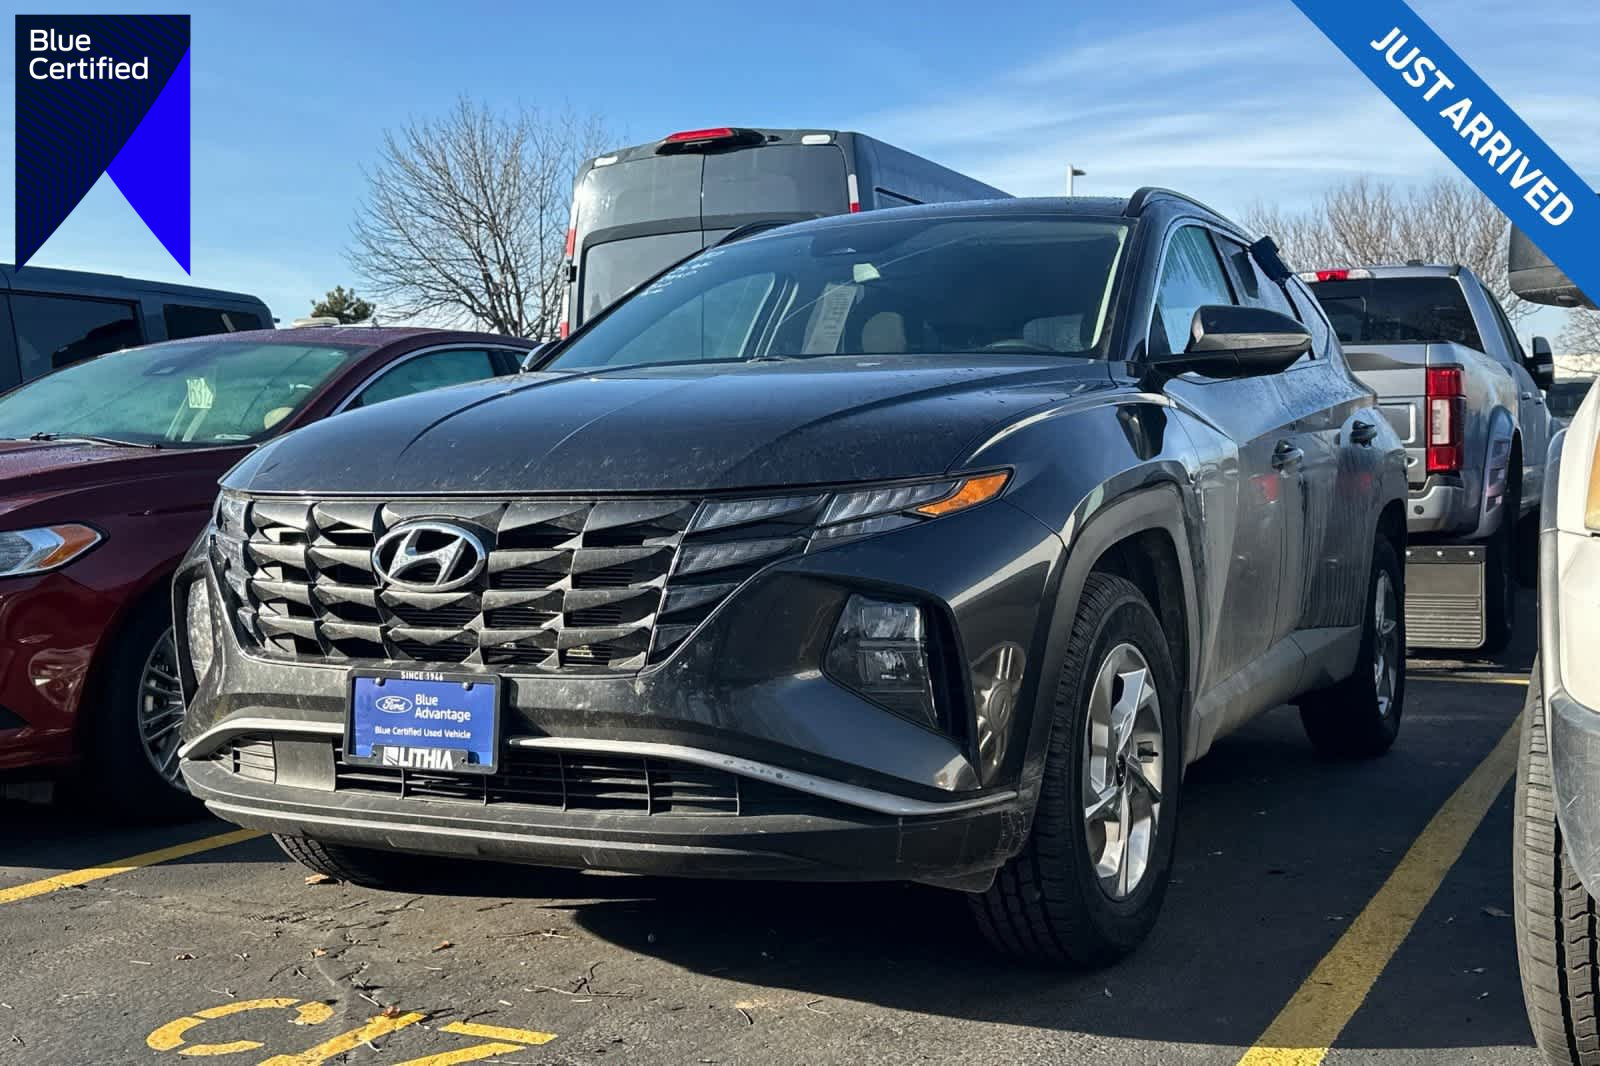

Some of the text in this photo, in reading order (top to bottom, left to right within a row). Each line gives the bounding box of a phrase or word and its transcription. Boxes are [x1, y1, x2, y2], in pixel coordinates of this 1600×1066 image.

[401, 671, 444, 682] SINCE 1946
[381, 698, 407, 712] Ford
[415, 694, 438, 706] Blue
[415, 707, 471, 723] Advantage
[375, 726, 471, 739] Blue Certified Used Vehicle
[399, 747, 453, 770] LITHIA
